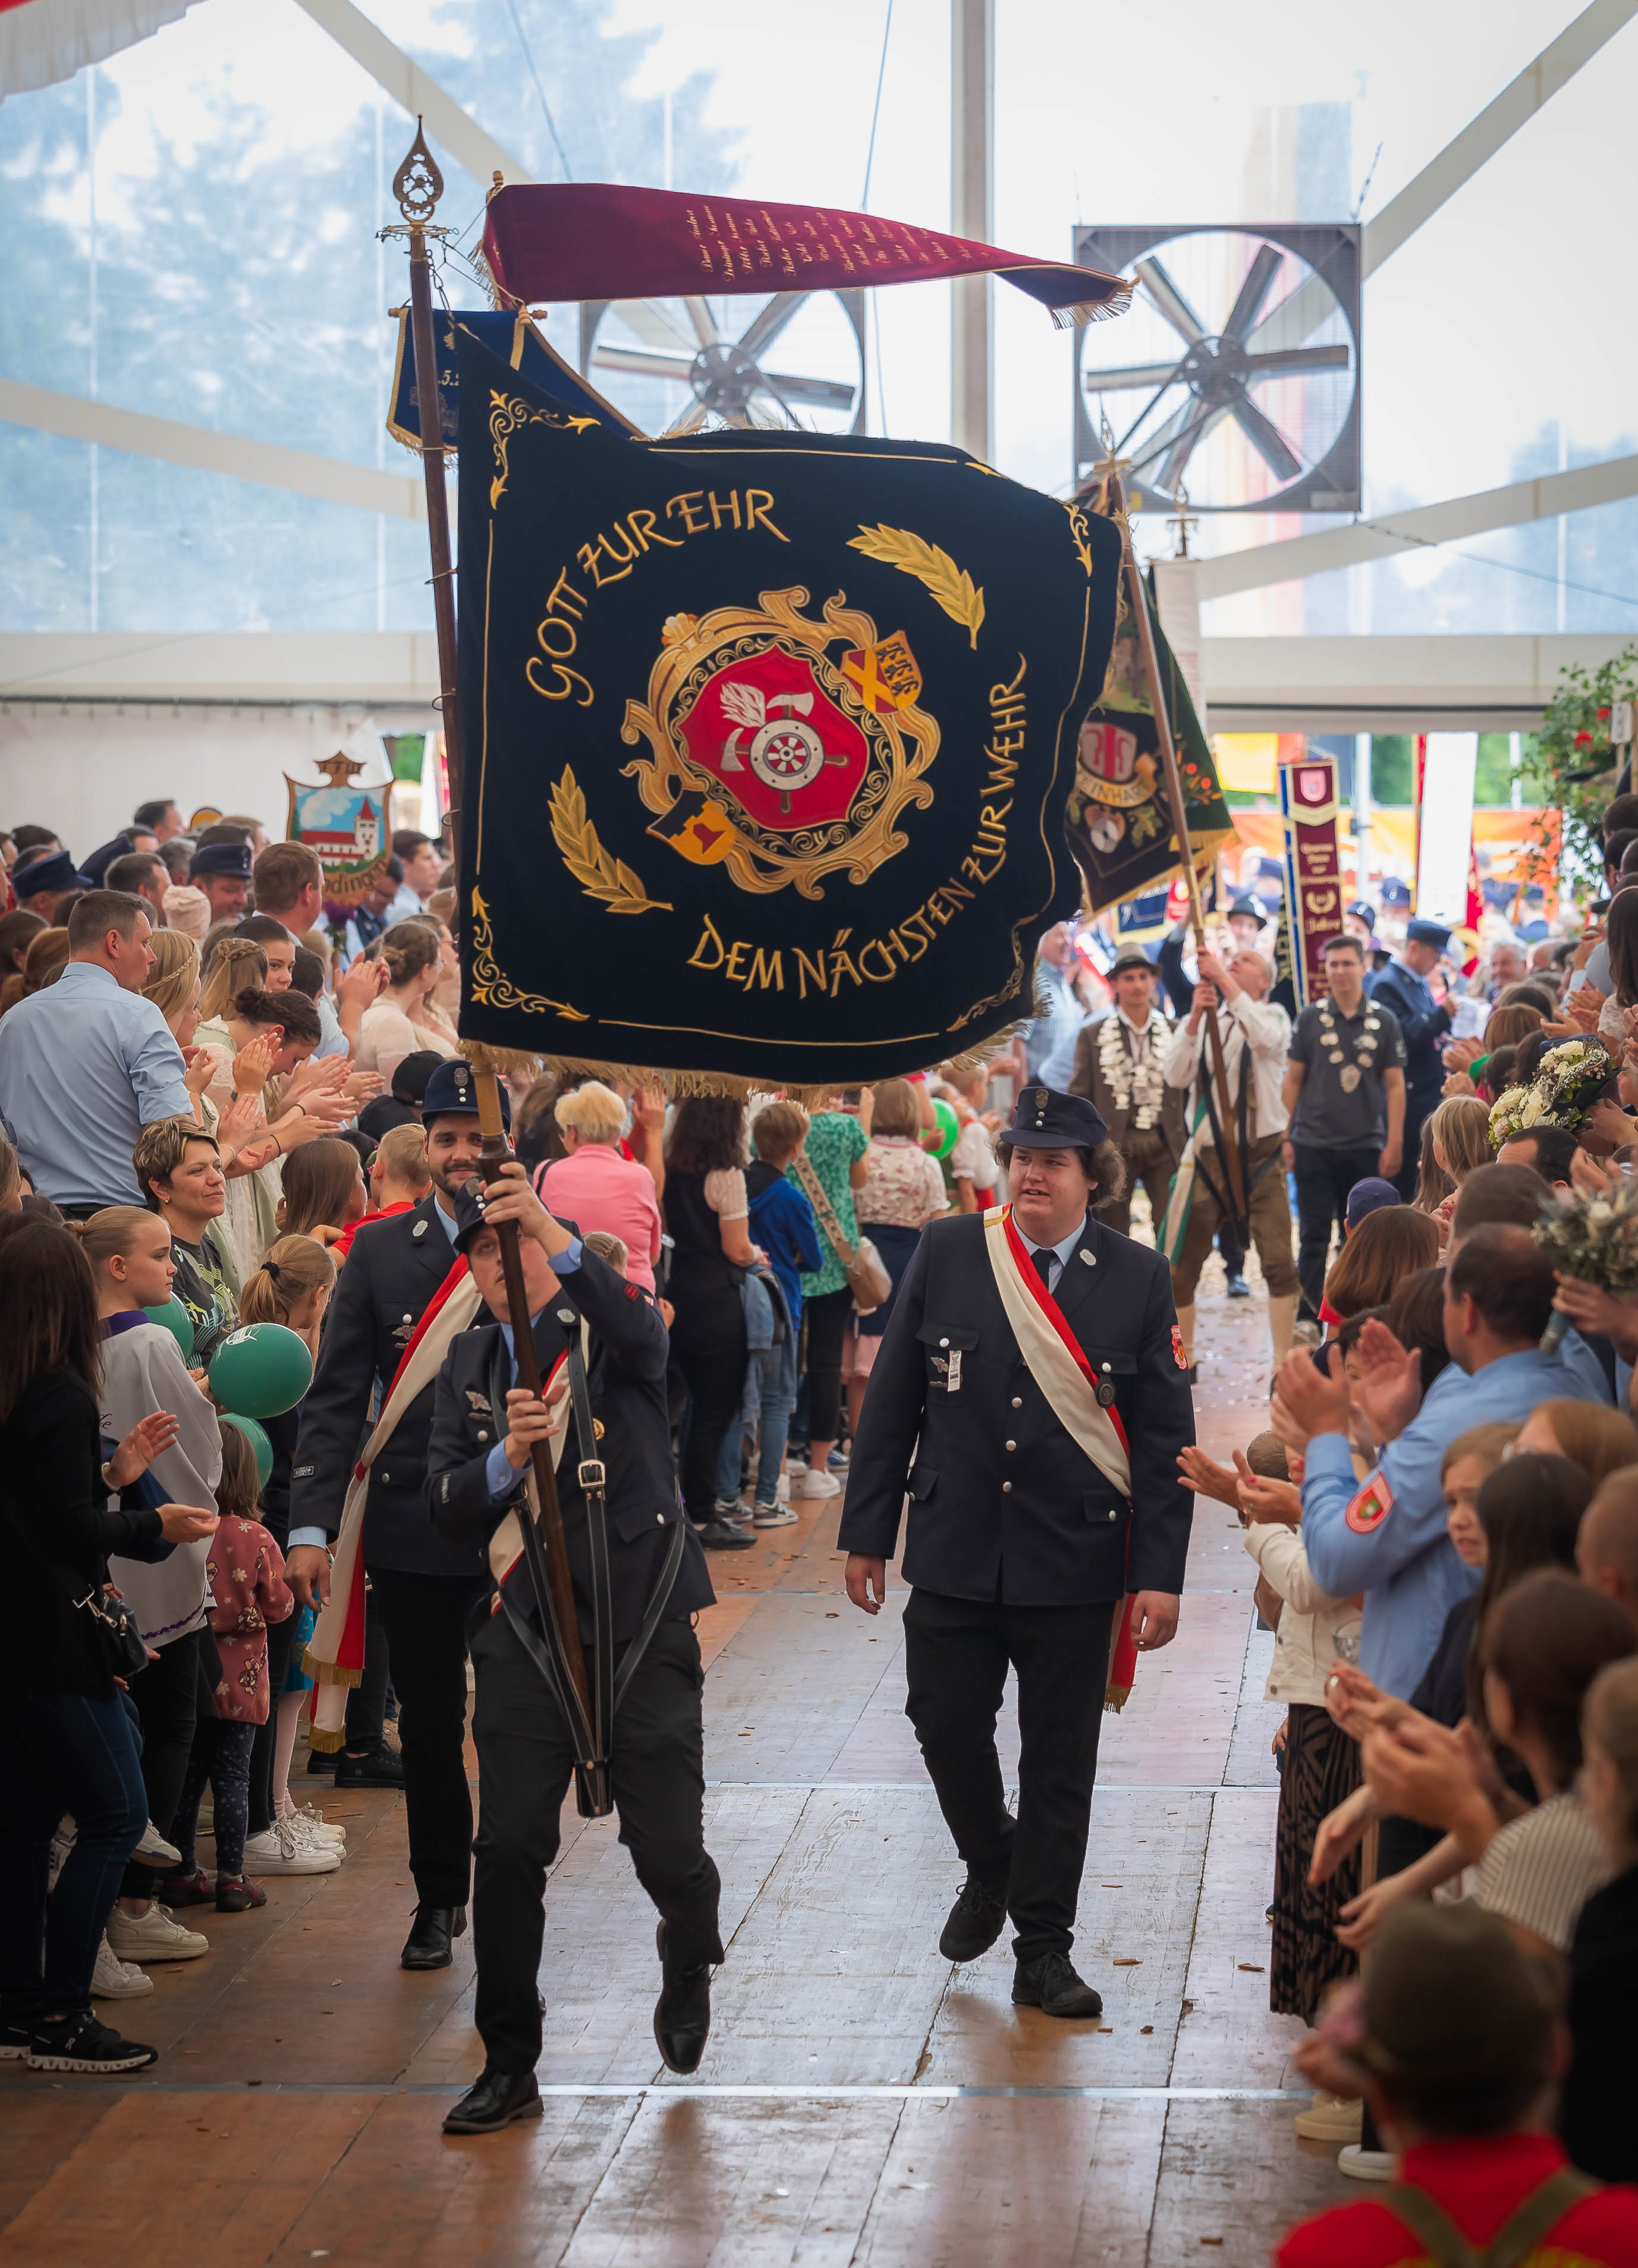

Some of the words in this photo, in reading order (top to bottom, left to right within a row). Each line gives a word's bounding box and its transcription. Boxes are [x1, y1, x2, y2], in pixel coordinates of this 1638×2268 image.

[526, 567, 593, 706] GOTT
[577, 510, 684, 588] ZUR
[666, 489, 790, 541] EHR
[980, 653, 1026, 796] WEHR
[962, 800, 1012, 882] ZUR
[687, 913, 784, 991] DEM
[792, 879, 974, 998] NÄCHSTEN
